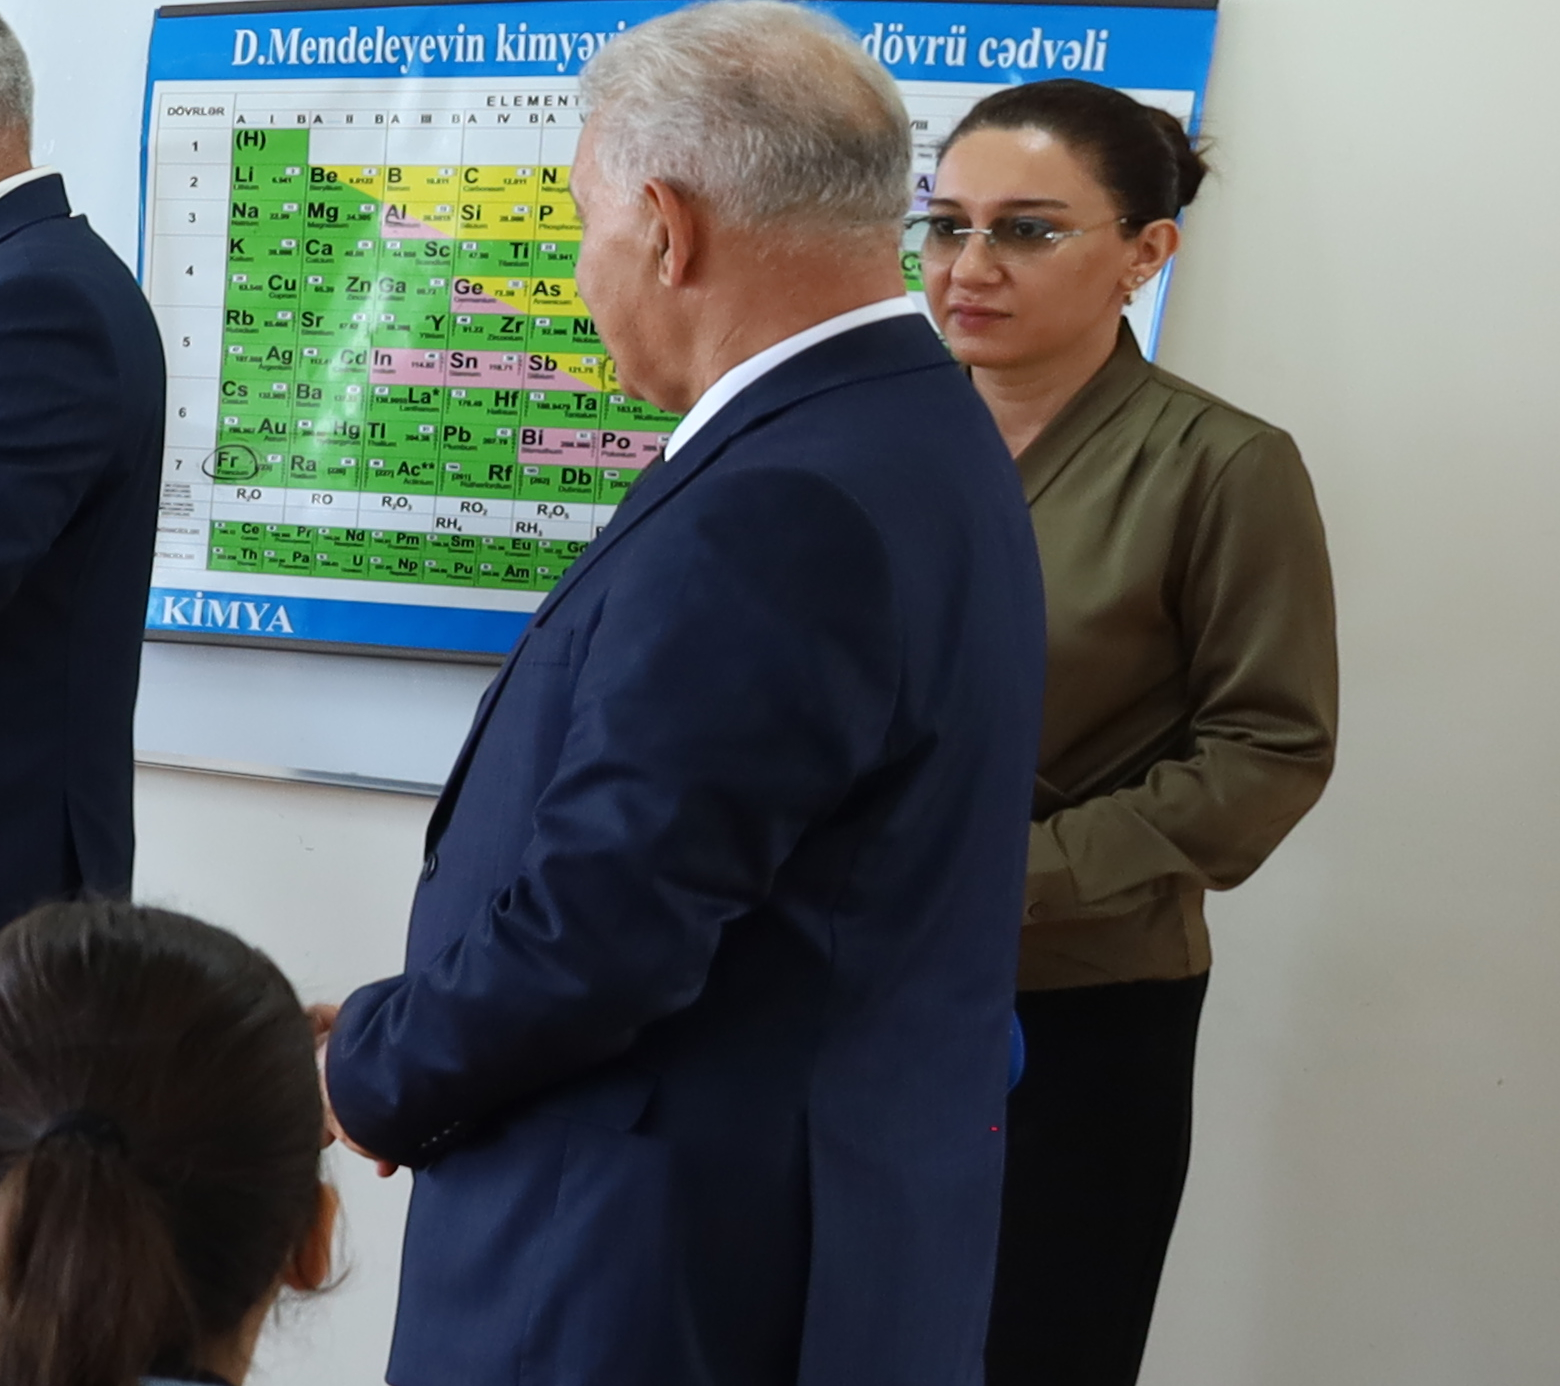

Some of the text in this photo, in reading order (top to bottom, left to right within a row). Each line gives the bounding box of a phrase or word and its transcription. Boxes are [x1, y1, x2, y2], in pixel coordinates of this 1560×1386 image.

[232, 23, 485, 74] D.Mendeleyevin
[861, 22, 1109, 71] dövrü cədvəli
[167, 106, 225, 116] DÖVRLƏR
[391, 115, 400, 123] A
[452, 114, 460, 123] B
[468, 114, 556, 123] A IV B A
[237, 115, 246, 124] A
[298, 115, 306, 124] B
[314, 115, 323, 124] A
[376, 115, 383, 124] B
[192, 142, 198, 151] 1
[236, 130, 266, 150] (H)
[235, 167, 253, 182] Li
[310, 168, 338, 183] Be
[388, 168, 402, 183] B
[465, 168, 479, 183] C
[542, 168, 557, 184] N
[190, 178, 198, 187] 2
[189, 213, 196, 223] 3
[233, 203, 259, 218] Na
[308, 203, 339, 222] Mg
[386, 205, 406, 220] Al
[461, 205, 481, 220] Si
[539, 206, 553, 221] P
[230, 239, 244, 254] K
[306, 240, 333, 255] Ca
[425, 242, 451, 257] Sc
[510, 243, 529, 259] Ti
[186, 266, 193, 276] 4
[268, 275, 296, 291] Cu
[347, 277, 371, 292] Zn
[379, 278, 406, 293] Ga
[455, 279, 484, 295] Ge
[533, 281, 561, 297] As
[226, 310, 254, 326] Rb
[301, 312, 324, 327] Sr
[500, 317, 524, 333] Zr
[183, 337, 191, 347] 5
[266, 346, 293, 364] Ag
[341, 350, 367, 365] Cd
[374, 351, 392, 366] In
[450, 352, 477, 369] Sn
[529, 356, 557, 371] Sb
[222, 381, 248, 397] Cs
[296, 384, 322, 400] Ba
[495, 391, 519, 407] Hf
[573, 394, 597, 410] Ta
[178, 408, 186, 418] 6
[258, 419, 286, 434] Au
[334, 421, 360, 439] Hg
[444, 426, 471, 443] Pb
[522, 430, 543, 445] Bi
[602, 432, 630, 449] Po
[175, 460, 182, 470] 7
[217, 452, 238, 468] Fr
[291, 456, 316, 472] Ra
[489, 465, 512, 481] Rf
[561, 468, 591, 485] Db
[312, 493, 333, 505] RO
[242, 523, 259, 534] Ce
[297, 527, 312, 537] Pr
[345, 530, 364, 541] Nd
[396, 533, 419, 545] Pm
[451, 536, 474, 548] Sm
[512, 540, 531, 550] Eu
[241, 548, 257, 560] Th
[293, 552, 310, 563] Pa
[353, 555, 362, 566] U
[398, 559, 418, 572] Np
[454, 563, 473, 574] Pu
[505, 566, 529, 578] Am
[162, 591, 294, 633] KİMYA
